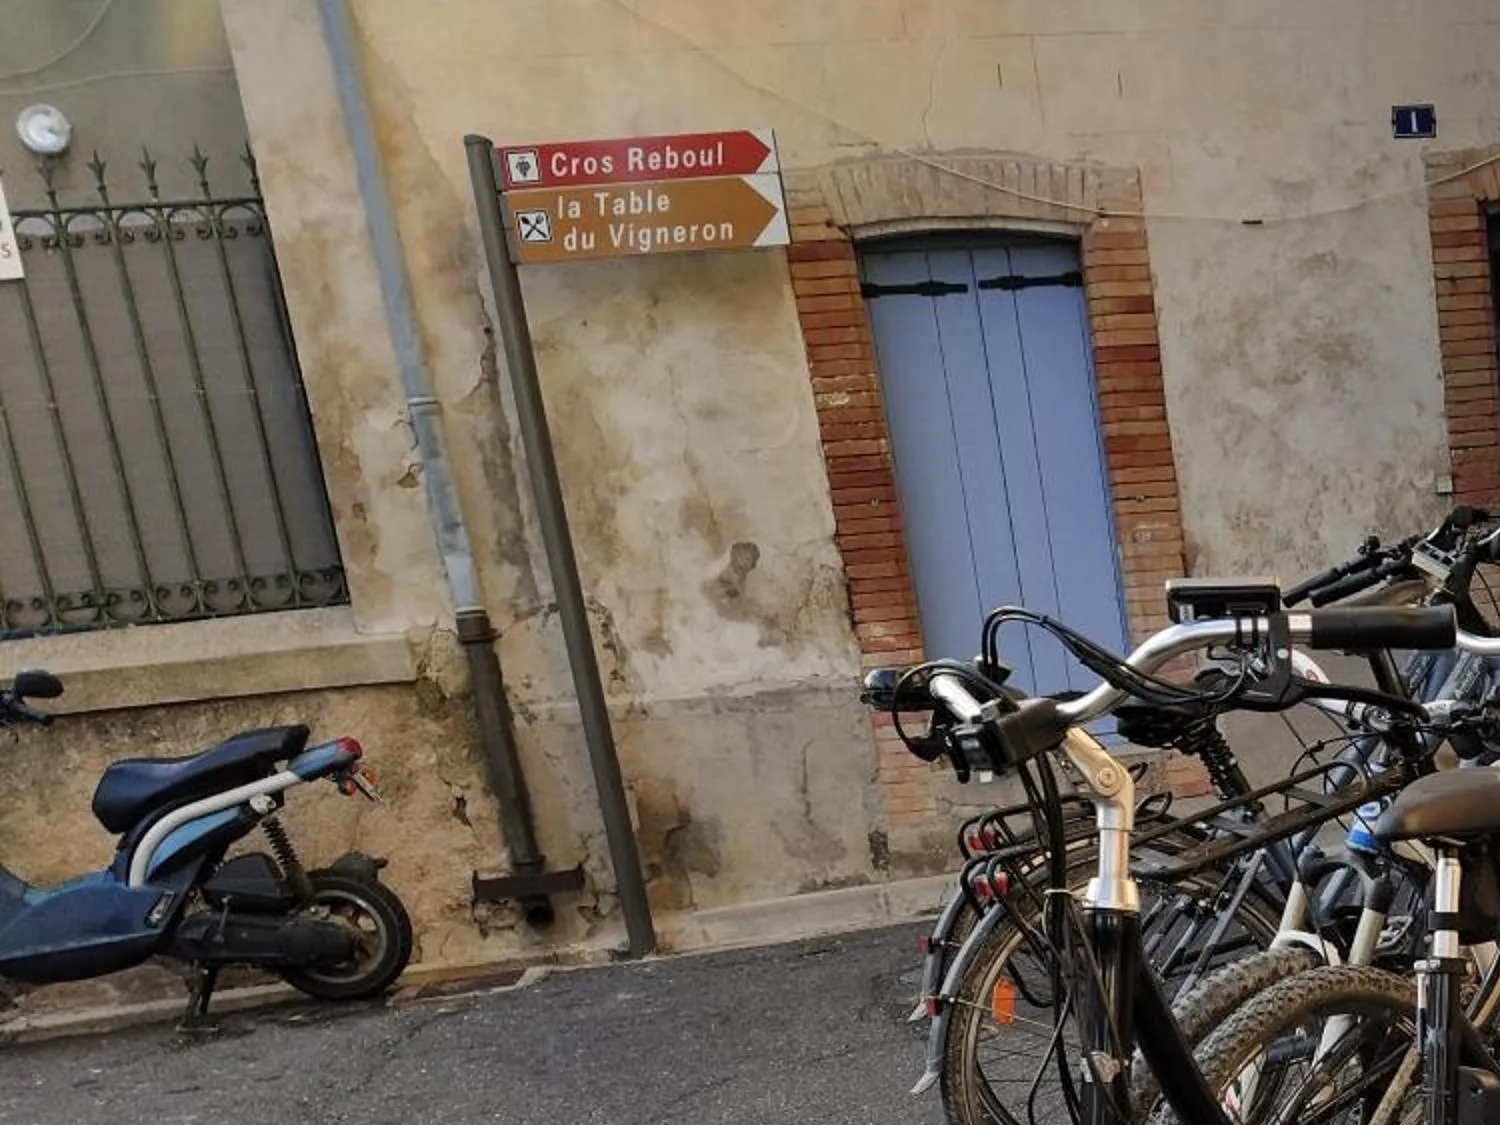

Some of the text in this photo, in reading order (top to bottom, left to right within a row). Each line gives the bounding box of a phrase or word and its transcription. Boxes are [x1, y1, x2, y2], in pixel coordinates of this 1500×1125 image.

[1411, 111, 1418, 133] 1
[551, 141, 724, 177] Cros Reboul
[557, 190, 672, 220] la Table
[563, 220, 734, 251] du Vigneron
